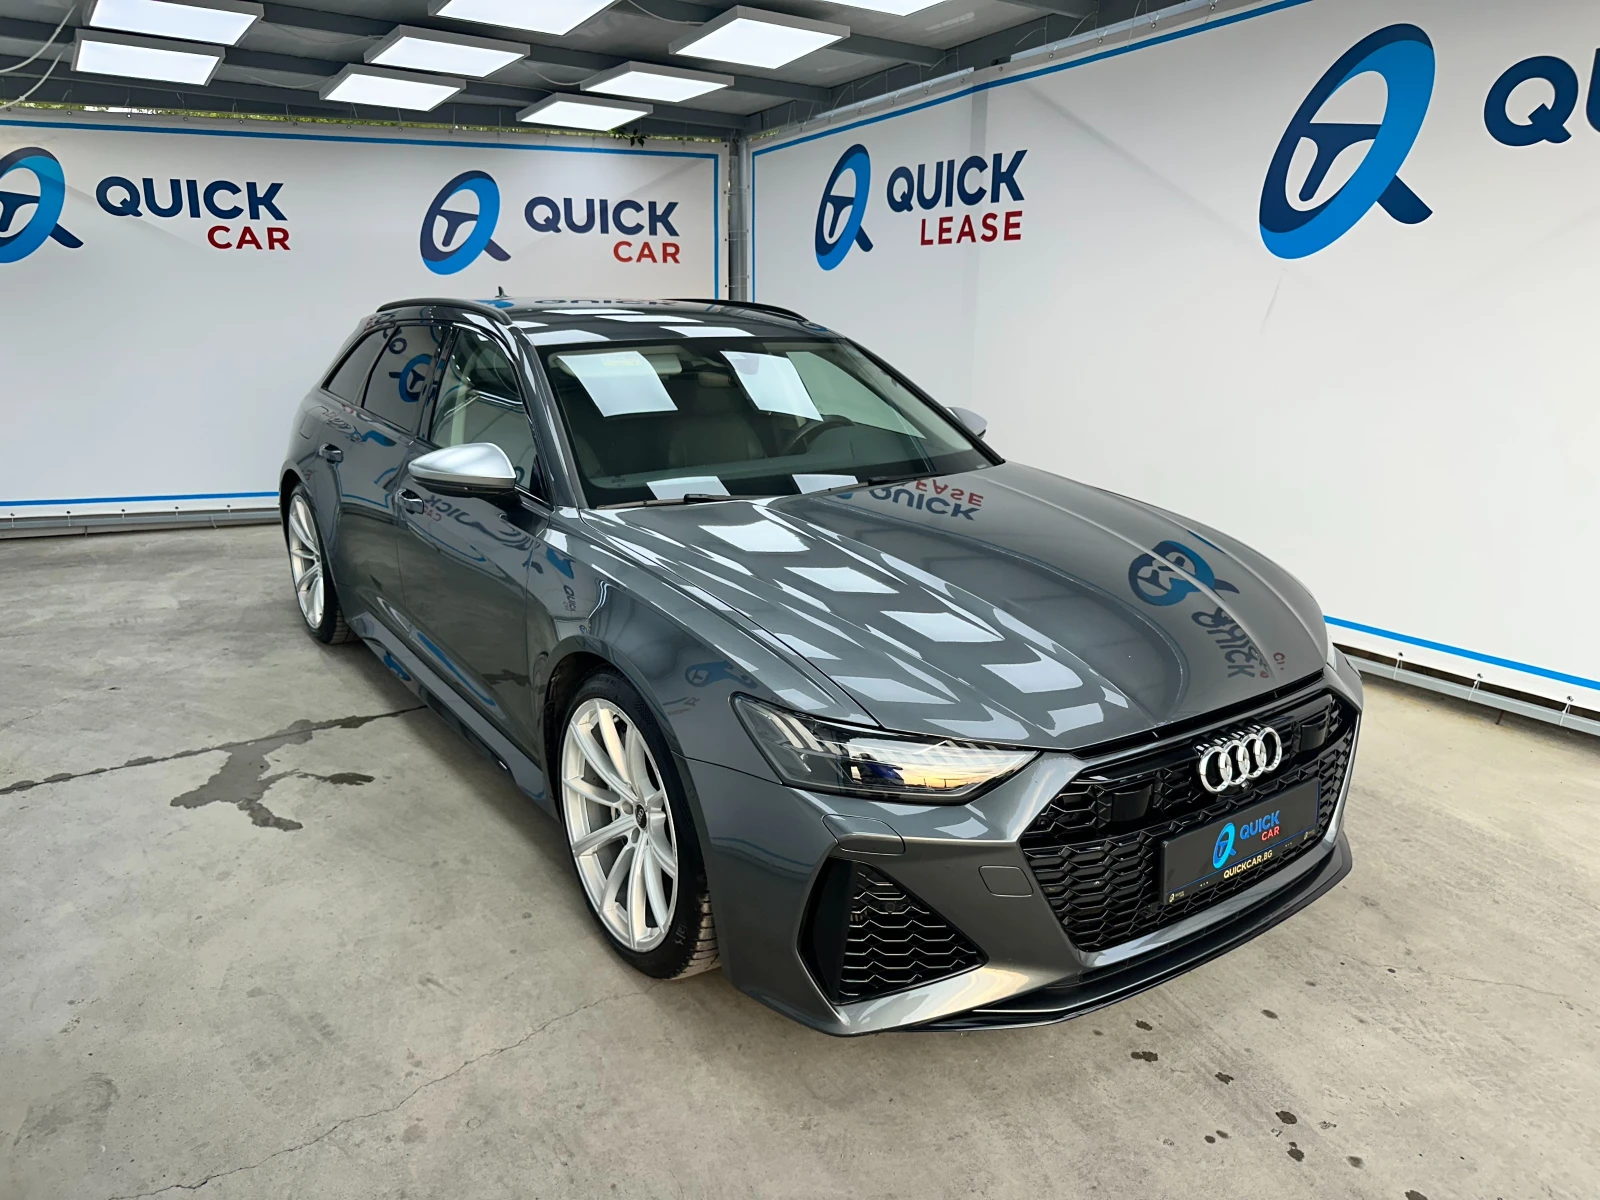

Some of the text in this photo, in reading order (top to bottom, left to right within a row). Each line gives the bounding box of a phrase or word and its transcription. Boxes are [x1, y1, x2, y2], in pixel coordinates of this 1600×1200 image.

[1484, 48, 1600, 147] Q
[887, 150, 1028, 213] QUICK
[96, 176, 288, 221] QUICK
[525, 196, 680, 237] QUICK
[921, 211, 1023, 246] LEASE
[208, 225, 290, 251] CAR
[613, 240, 681, 264] CAR
[1240, 810, 1280, 840] QUICK
[1261, 825, 1280, 842] CAR
[1223, 849, 1273, 879] QUICKCAR.BG
